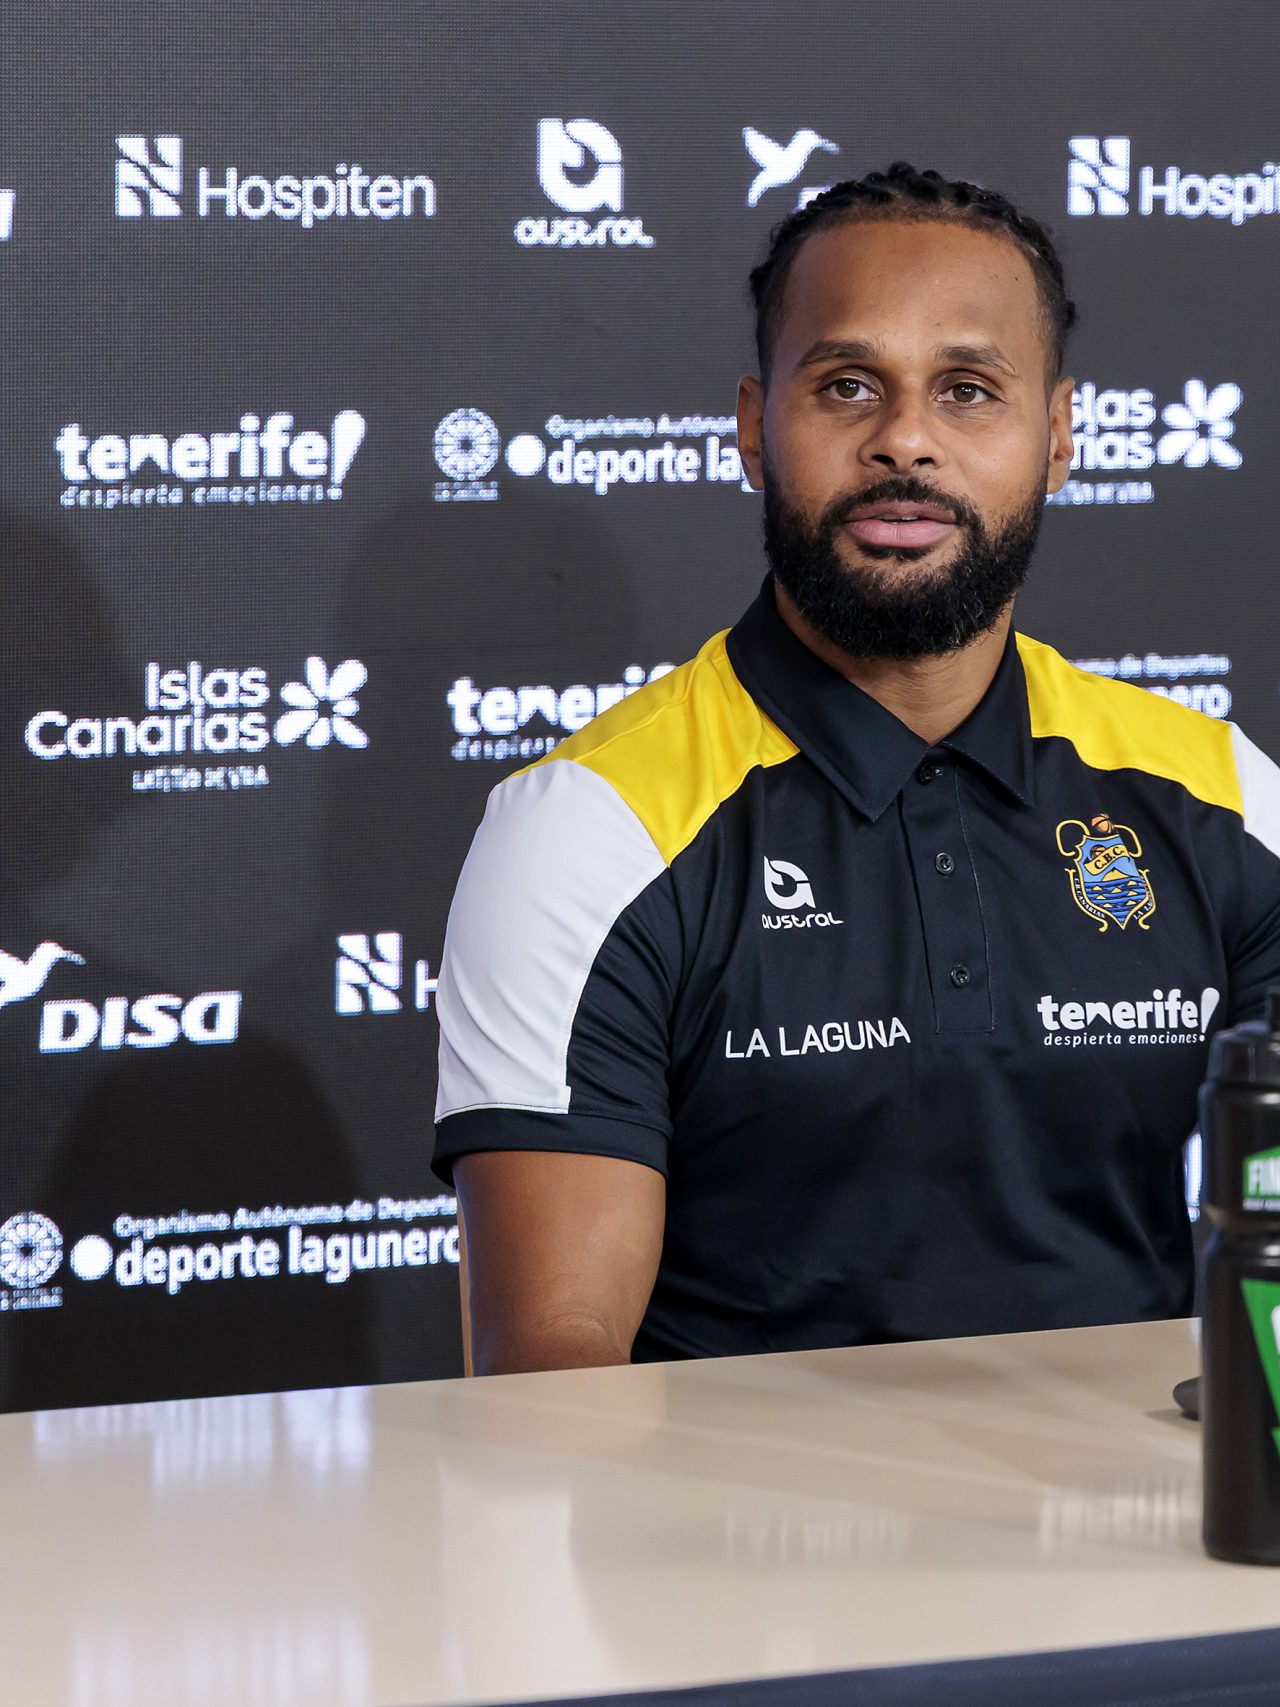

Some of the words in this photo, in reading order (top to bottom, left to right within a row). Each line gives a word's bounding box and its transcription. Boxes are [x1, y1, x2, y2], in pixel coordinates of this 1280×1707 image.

[198, 164, 437, 228] Hospiten
[56, 410, 366, 500] tenerife!
[548, 438, 700, 496] deporte
[145, 660, 270, 718] Islas
[25, 710, 270, 760] Canarias
[761, 911, 845, 930] austral
[725, 1030, 771, 1059] LA
[778, 1016, 912, 1056] LAGUNA
[1036, 987, 1220, 1042] tenerife!
[1043, 1033, 1122, 1048] despierta
[1128, 1032, 1199, 1045] emociones
[115, 1236, 280, 1295] deporte
